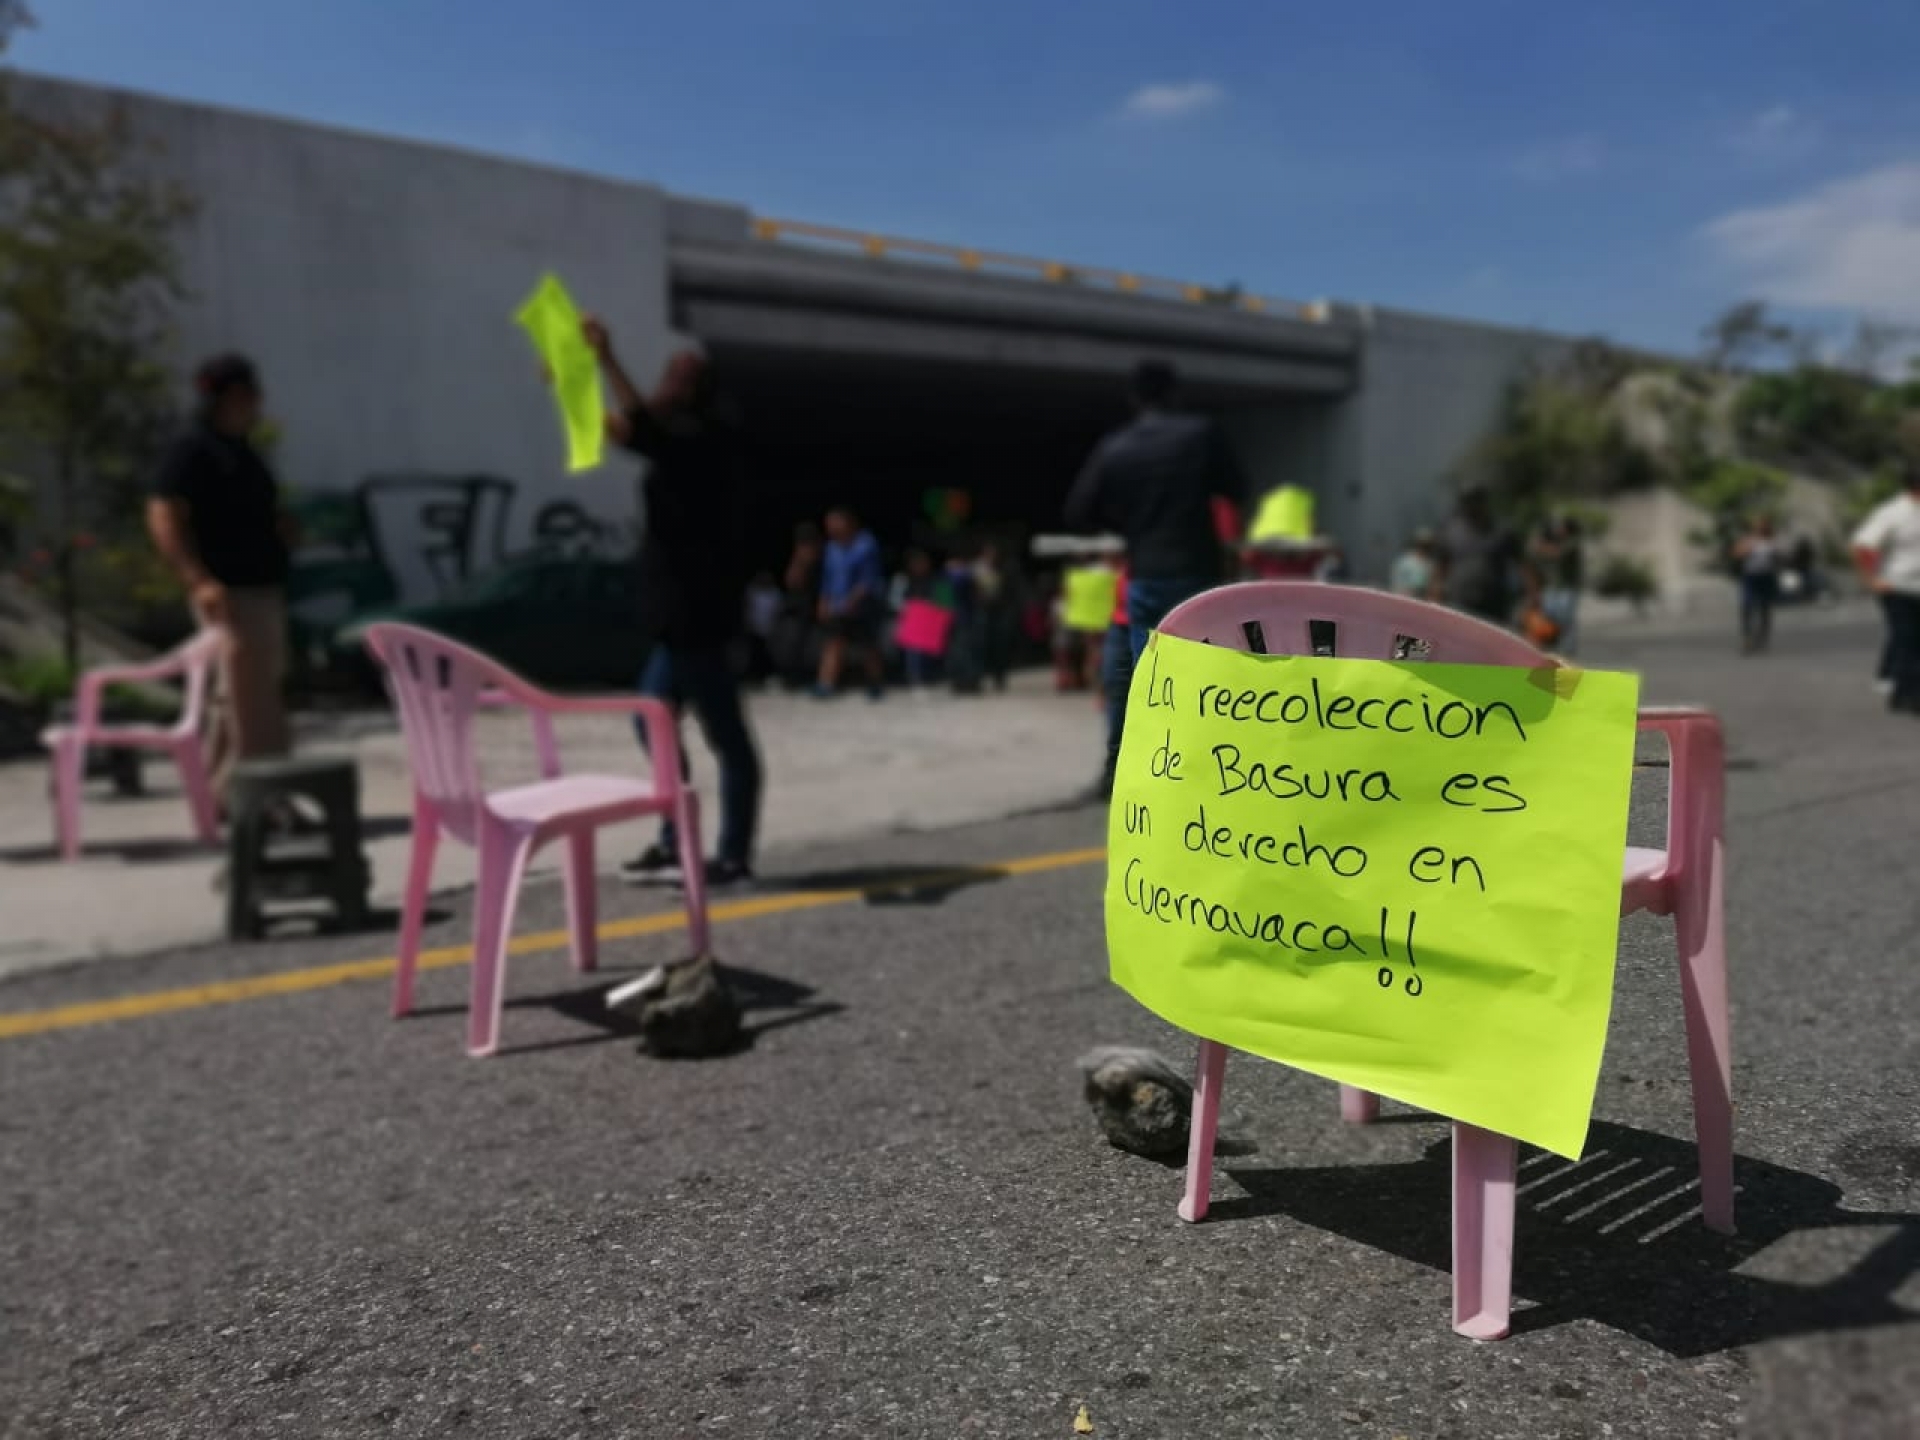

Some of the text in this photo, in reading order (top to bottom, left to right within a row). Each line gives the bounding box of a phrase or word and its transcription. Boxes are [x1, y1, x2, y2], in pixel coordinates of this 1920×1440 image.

[1148, 655, 1526, 741] La reecoleccion
[1152, 729, 1527, 812] de Basura es
[1125, 801, 1485, 891] un derecho en
[1125, 858, 1423, 996] Cuernavaca!!
